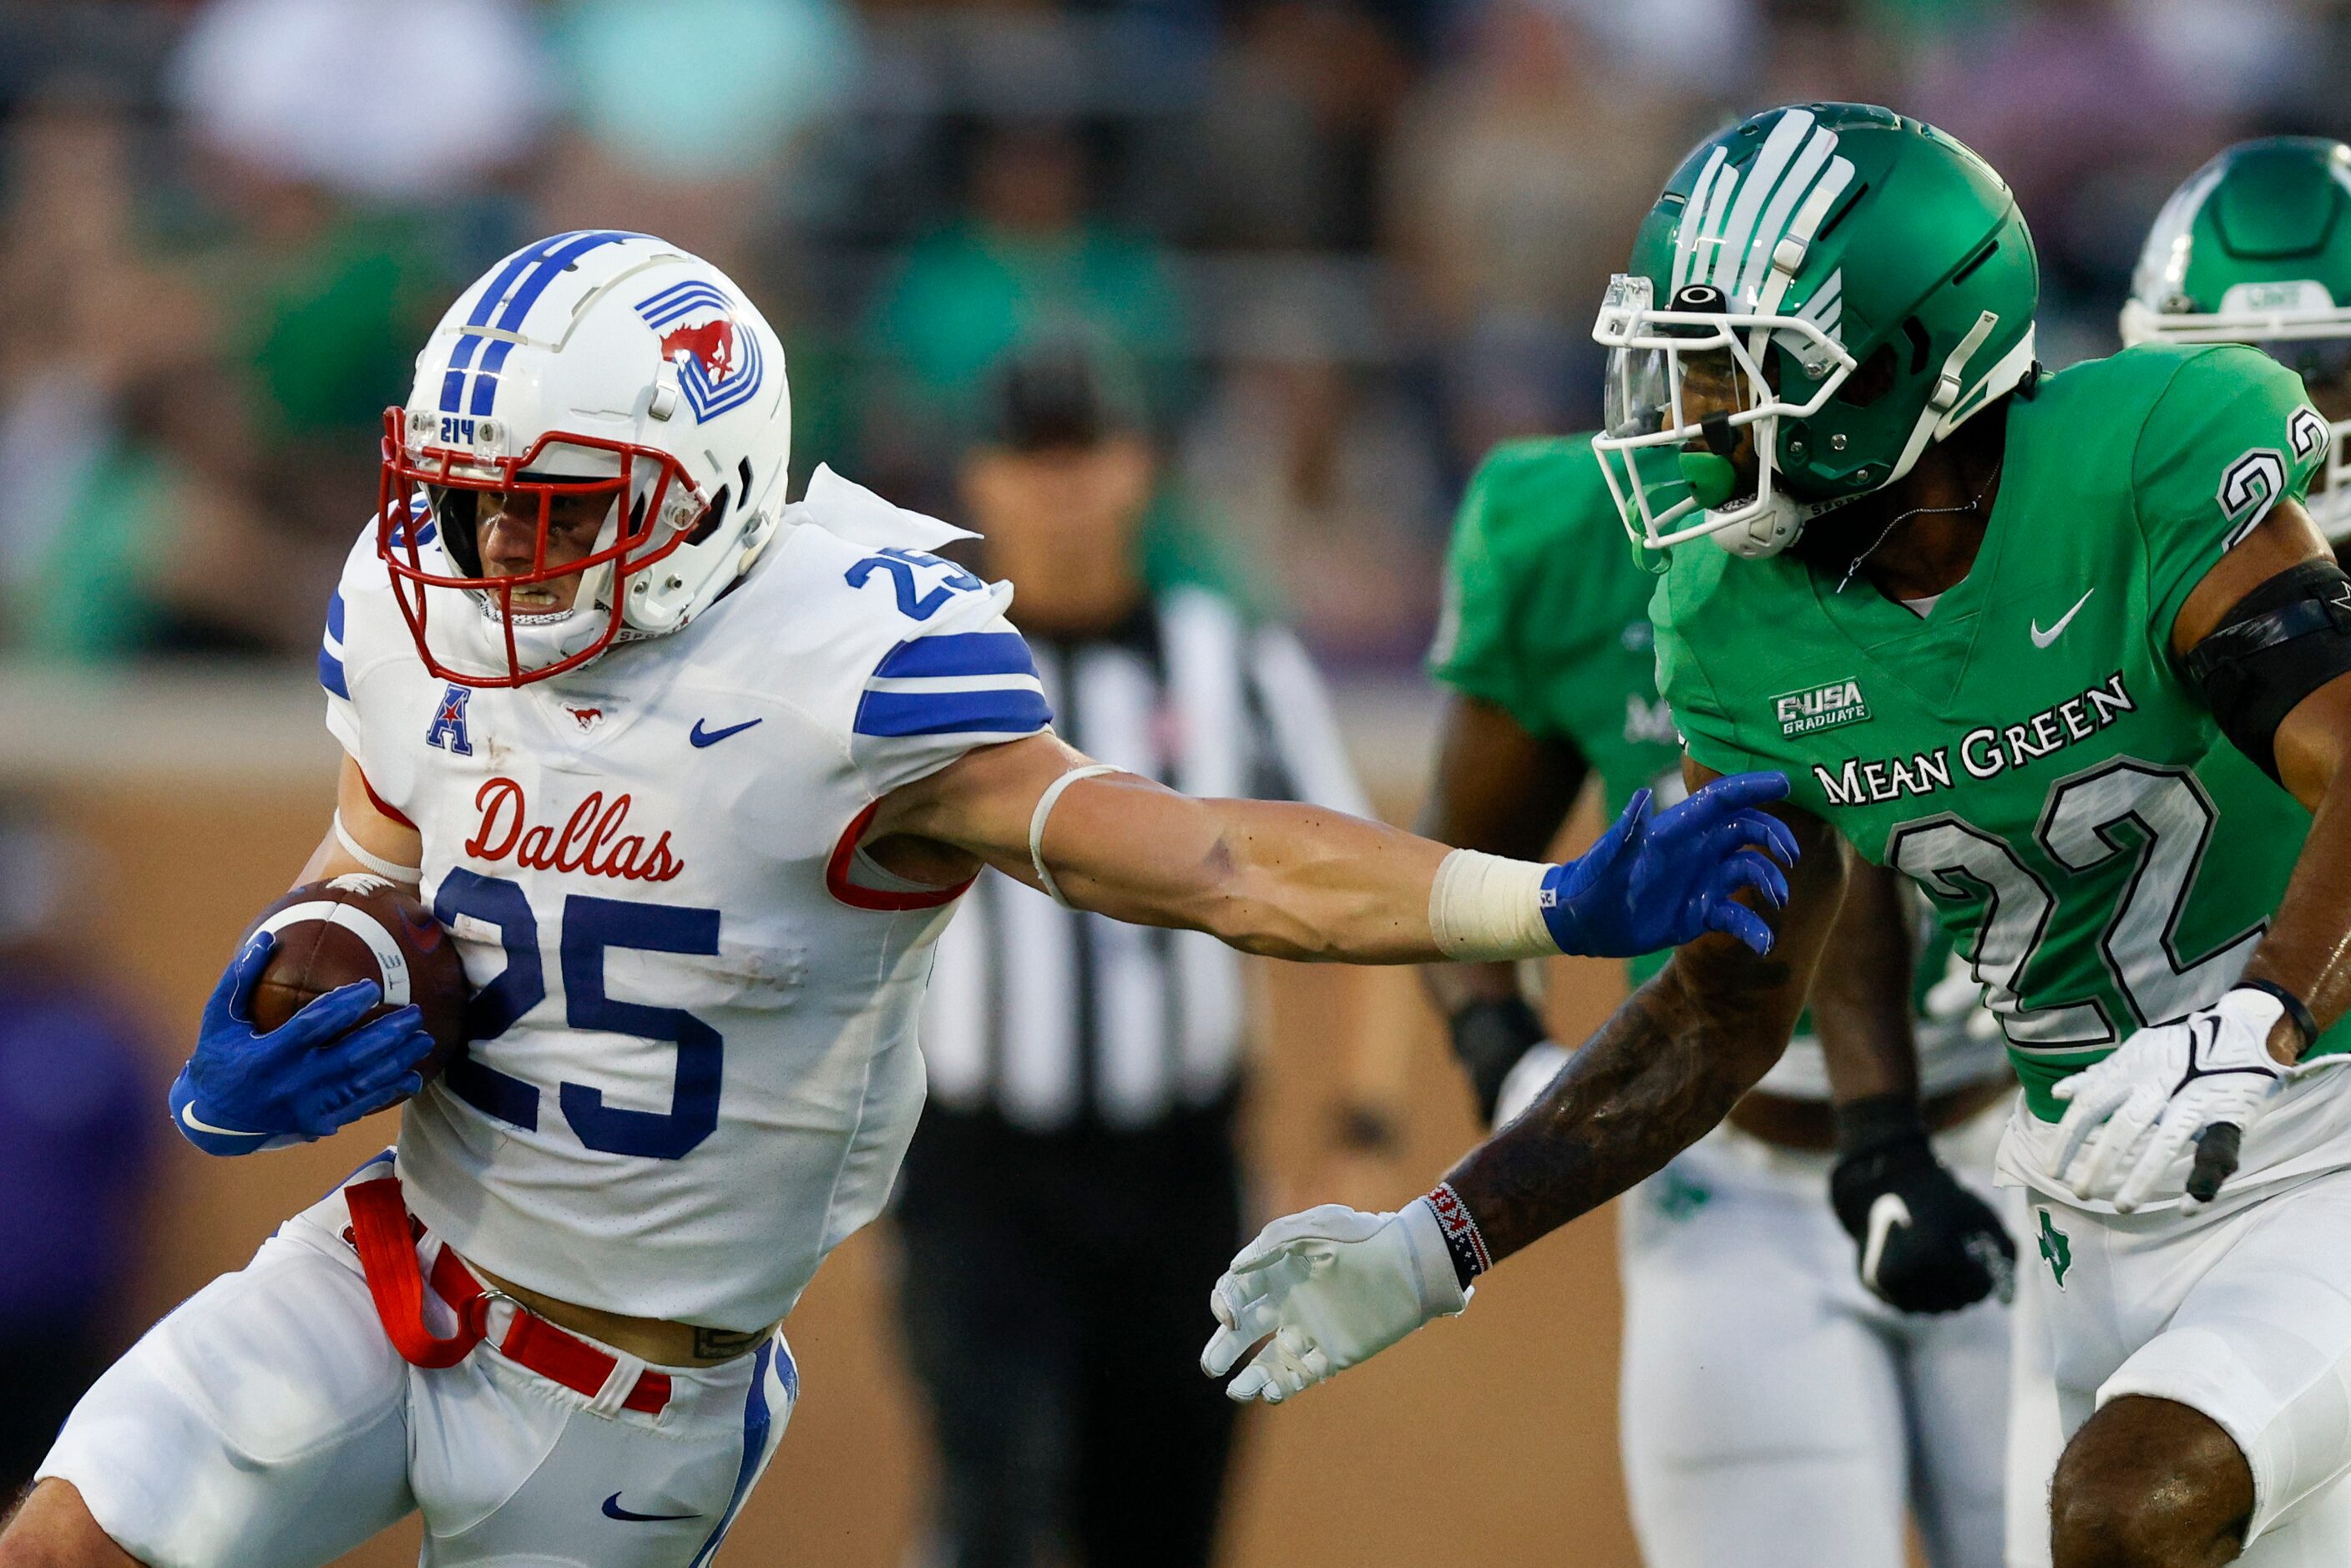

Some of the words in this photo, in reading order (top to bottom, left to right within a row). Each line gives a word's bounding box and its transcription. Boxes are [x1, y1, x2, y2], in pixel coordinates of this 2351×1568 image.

[440, 417, 475, 445] 214
[844, 547, 983, 621] 25
[1782, 705, 1865, 735] GRADUATE
[464, 776, 685, 883] Dallas
[1884, 754, 2270, 1055] 22
[433, 866, 724, 1160] 25
